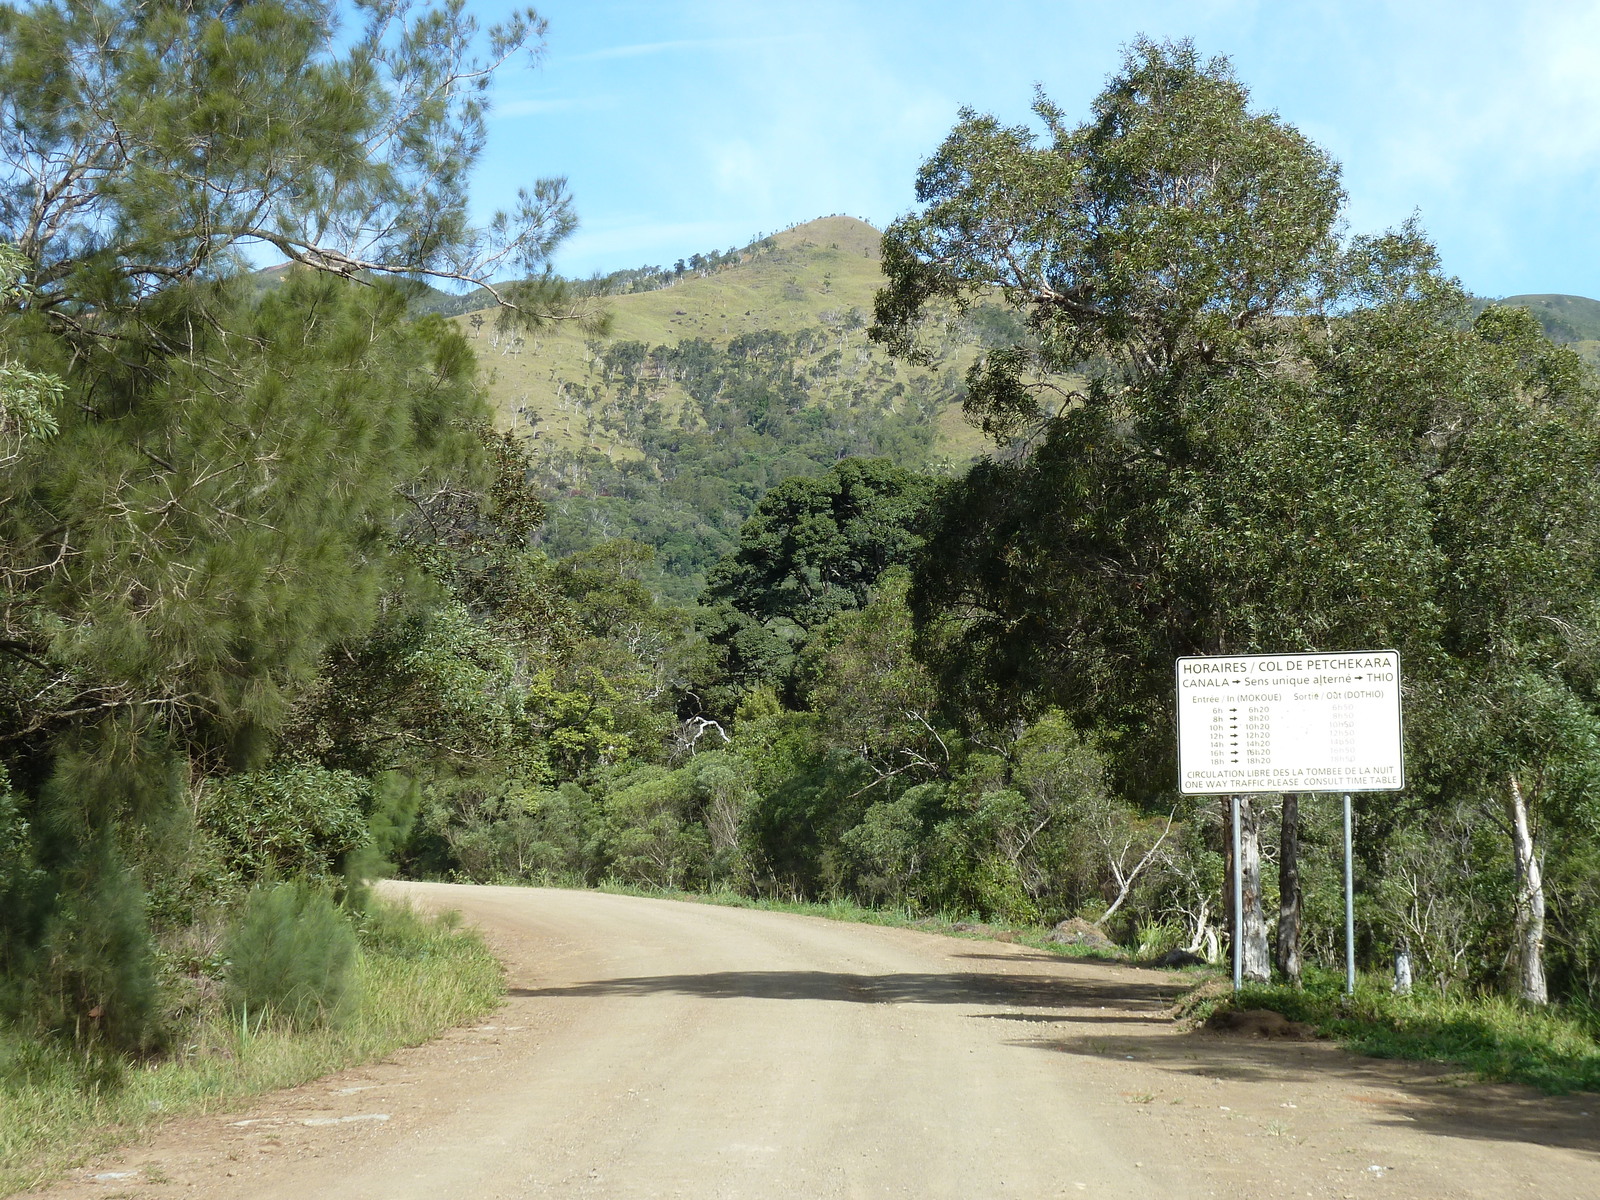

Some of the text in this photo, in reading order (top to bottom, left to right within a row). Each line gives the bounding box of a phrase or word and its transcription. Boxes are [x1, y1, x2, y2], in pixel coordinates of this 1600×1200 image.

[1184, 663, 1246, 674] HORAIRES
[1259, 662, 1282, 671] COL
[1287, 661, 1302, 670] DE
[1307, 658, 1391, 669] PETCHEKARA
[1183, 679, 1229, 688] CANALA
[1245, 677, 1269, 686] Sens
[1273, 676, 1309, 687] unique
[1367, 673, 1393, 681] THIO
[1193, 695, 1219, 703] Entrée
[1237, 694, 1281, 702] (MOKOUE)
[1344, 690, 1384, 698] (DOTHIO)
[1187, 770, 1244, 778] CIRCULATION
[1247, 769, 1270, 777] LIBRE
[1345, 767, 1356, 775] DE
[1373, 766, 1394, 774] NUIT
[1230, 779, 1264, 787] TRAFFIC
[1267, 778, 1298, 786] PLEASE
[1304, 777, 1343, 785] CONSULT
[1370, 776, 1396, 784] TABLE
